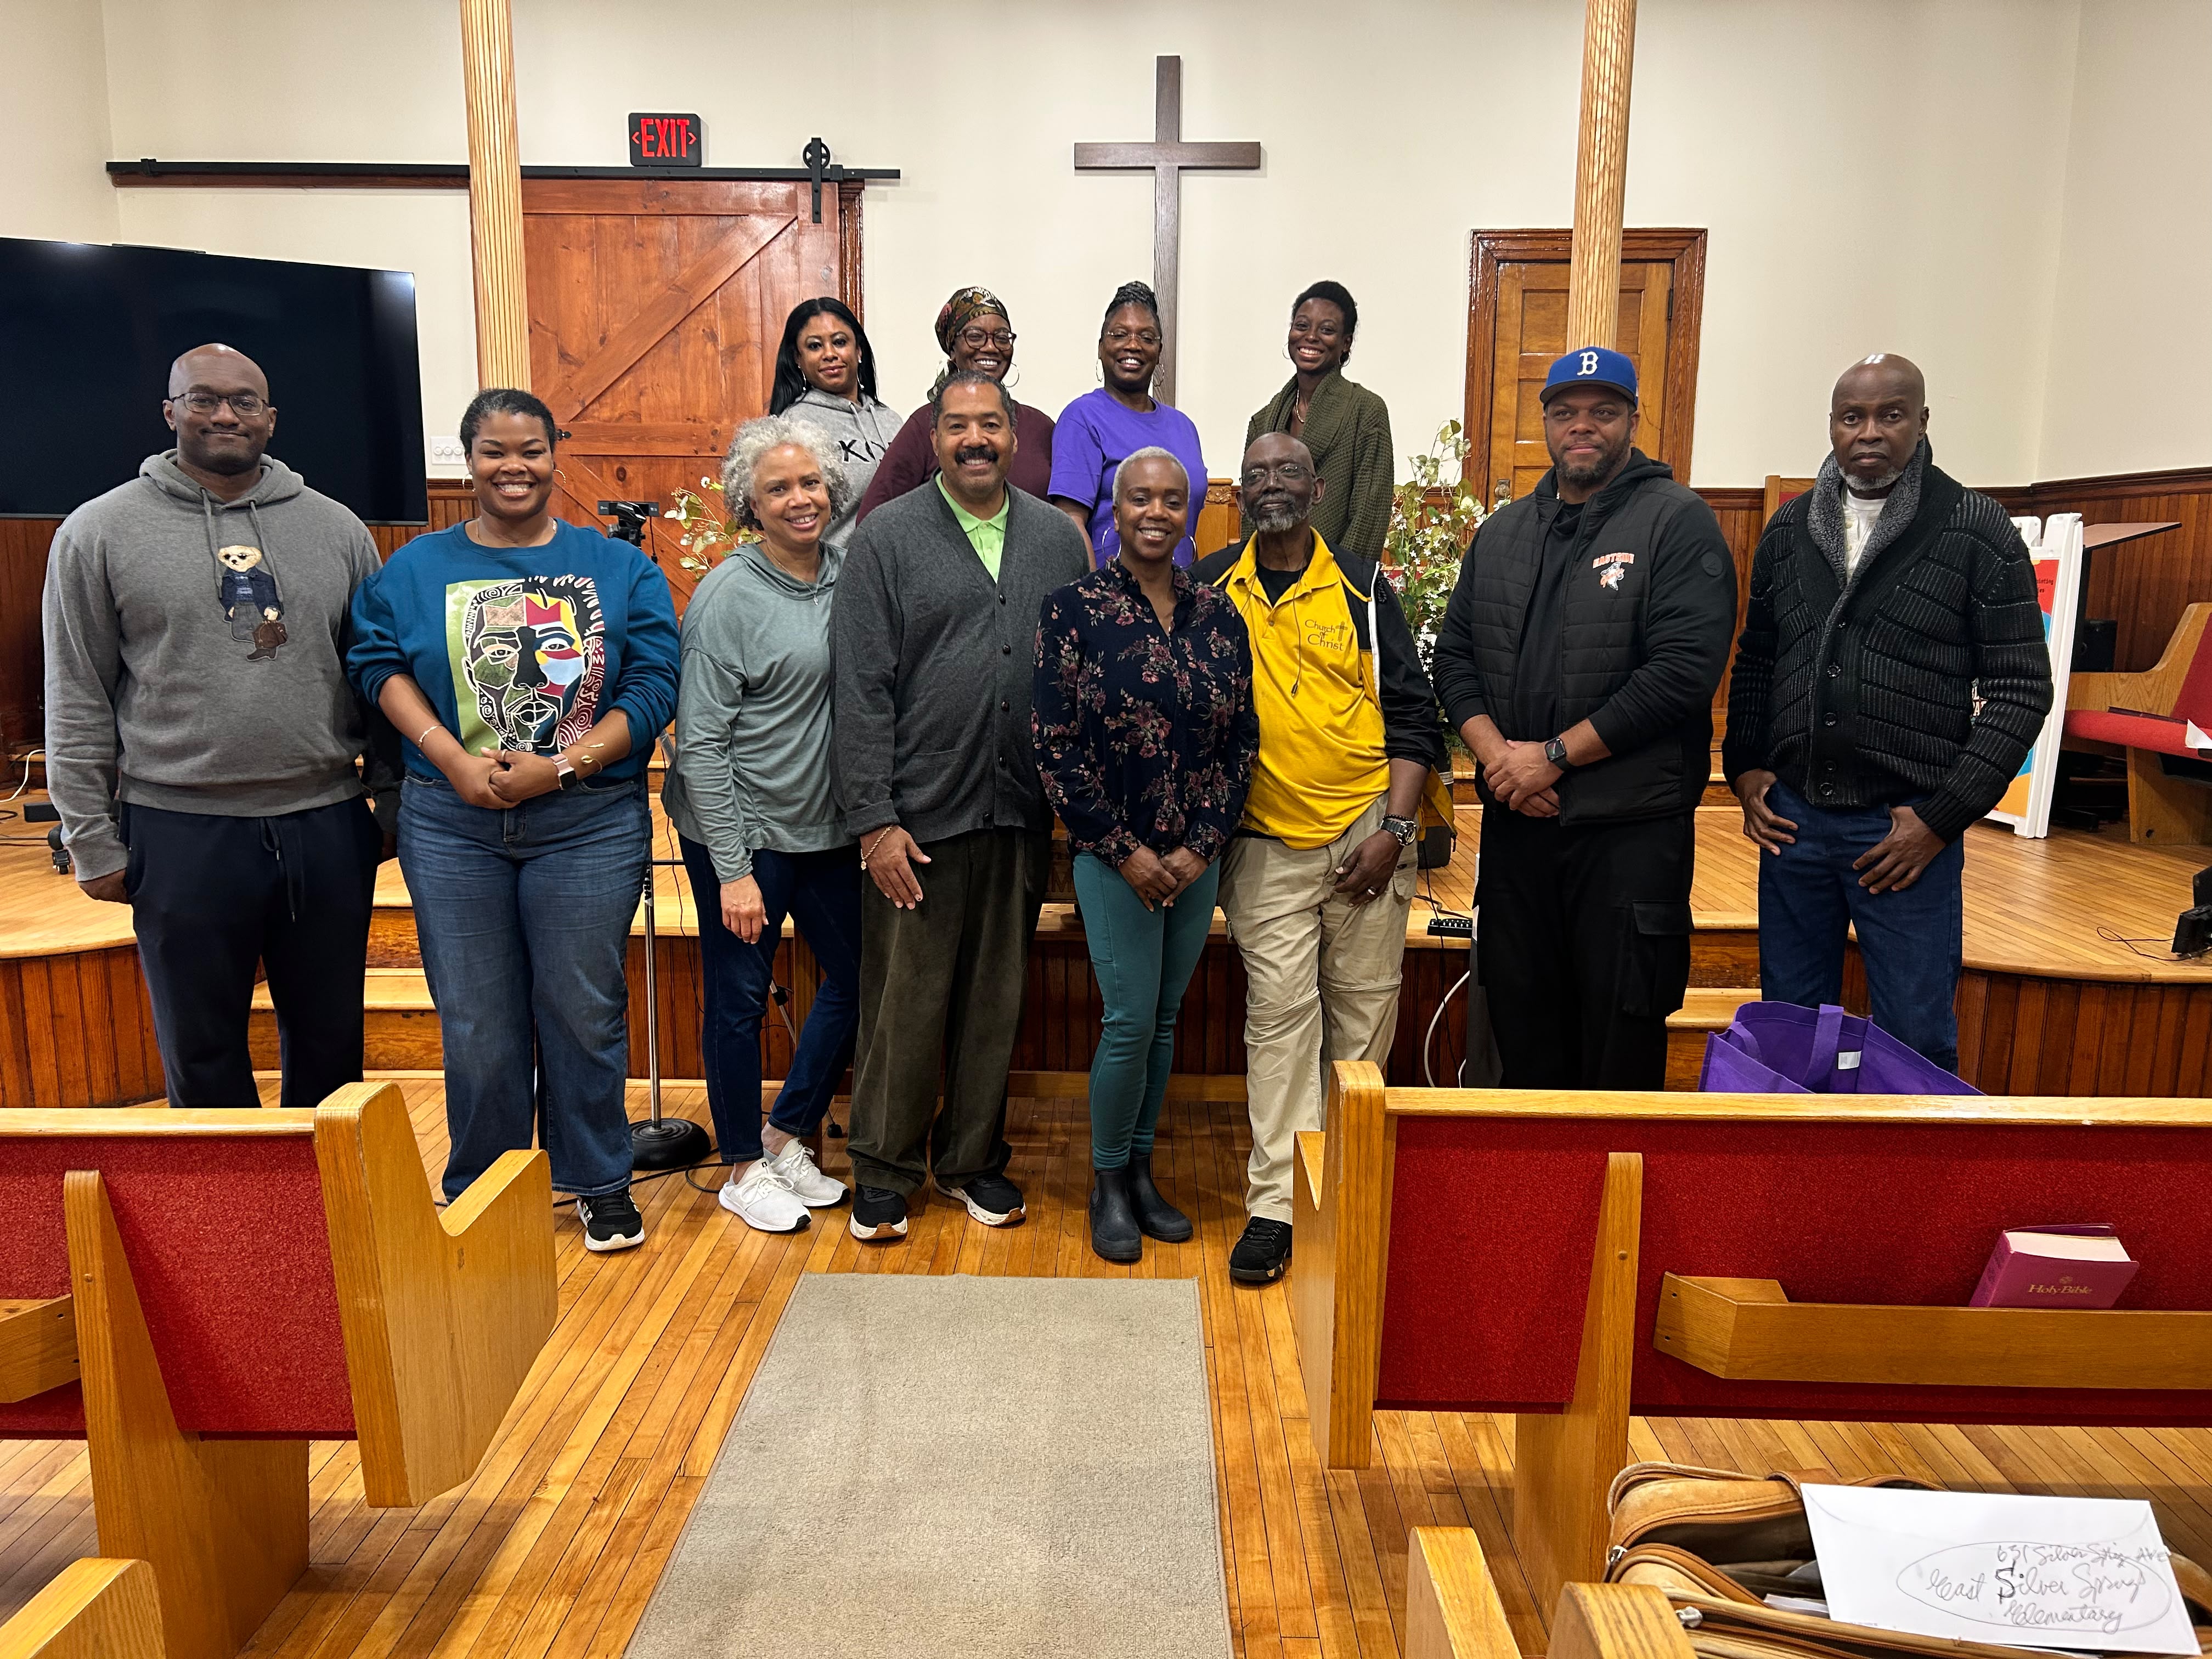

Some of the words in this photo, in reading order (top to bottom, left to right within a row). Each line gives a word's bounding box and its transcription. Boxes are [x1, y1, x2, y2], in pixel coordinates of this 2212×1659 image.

[641, 119, 690, 157] EXIT
[1577, 351, 1599, 376] B
[1305, 619, 1335, 633] Church
[1319, 631, 1328, 639] of
[1307, 634, 1344, 651] Christ
[2028, 1284, 2057, 1295] Holy
[2060, 1285, 2092, 1294] Bible
[1995, 1560, 2068, 1604] Silver
[2004, 1600, 2123, 1634] Elementary
